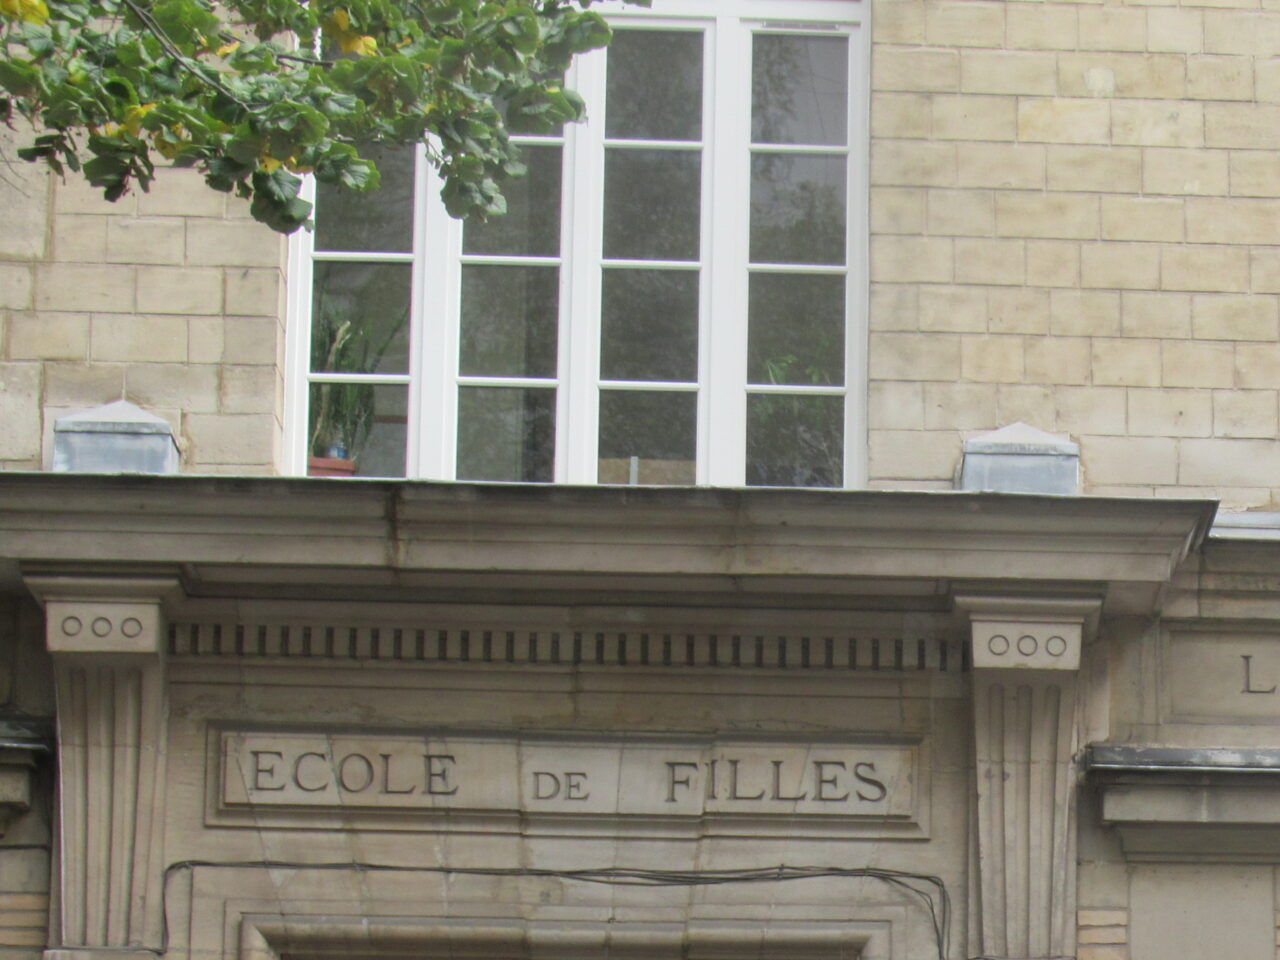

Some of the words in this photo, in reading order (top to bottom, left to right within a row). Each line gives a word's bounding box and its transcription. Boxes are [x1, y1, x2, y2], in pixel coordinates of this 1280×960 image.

[250, 750, 459, 796] ECOLE
[531, 771, 592, 801] DE
[664, 760, 890, 802] FILLES
